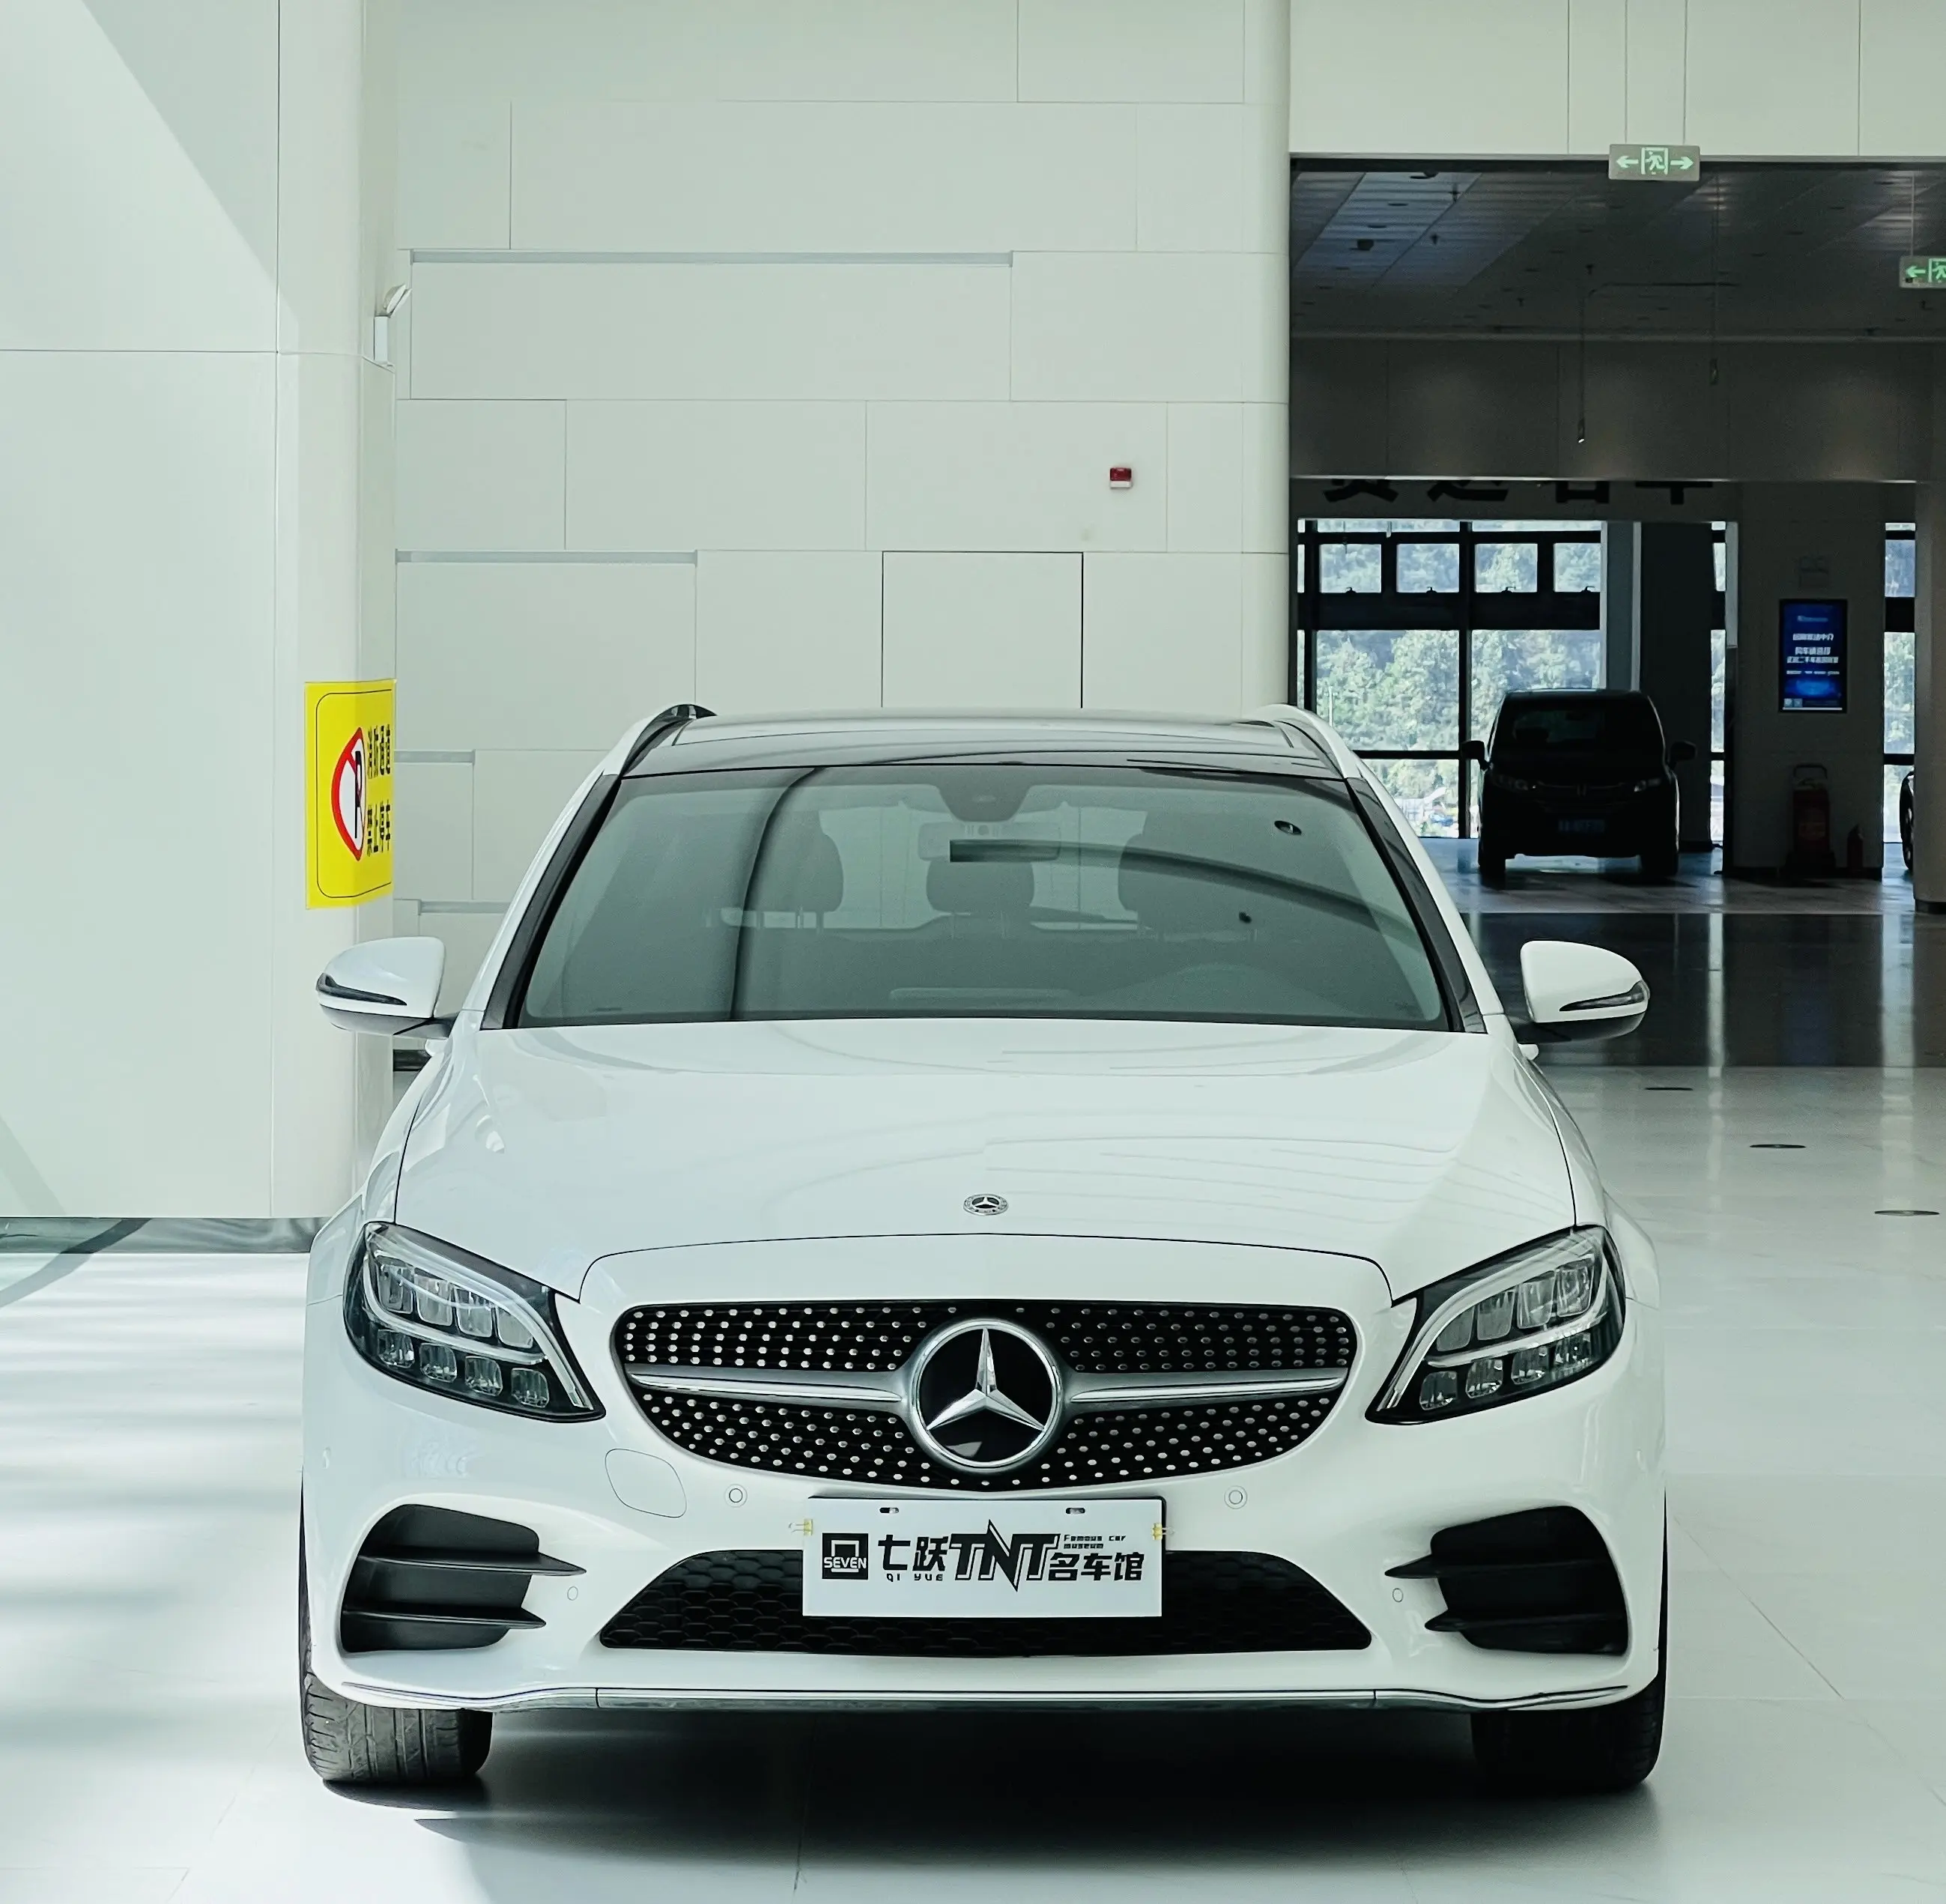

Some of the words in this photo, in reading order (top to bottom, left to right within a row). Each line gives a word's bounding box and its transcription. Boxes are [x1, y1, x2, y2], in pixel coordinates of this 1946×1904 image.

[366, 799, 390, 857] 禁止停车
[824, 1556, 867, 1569] SEVEN
[878, 1534, 948, 1571] 七跃
[949, 1519, 1061, 1592] TNT
[1048, 1552, 1145, 1581] 名车馆
